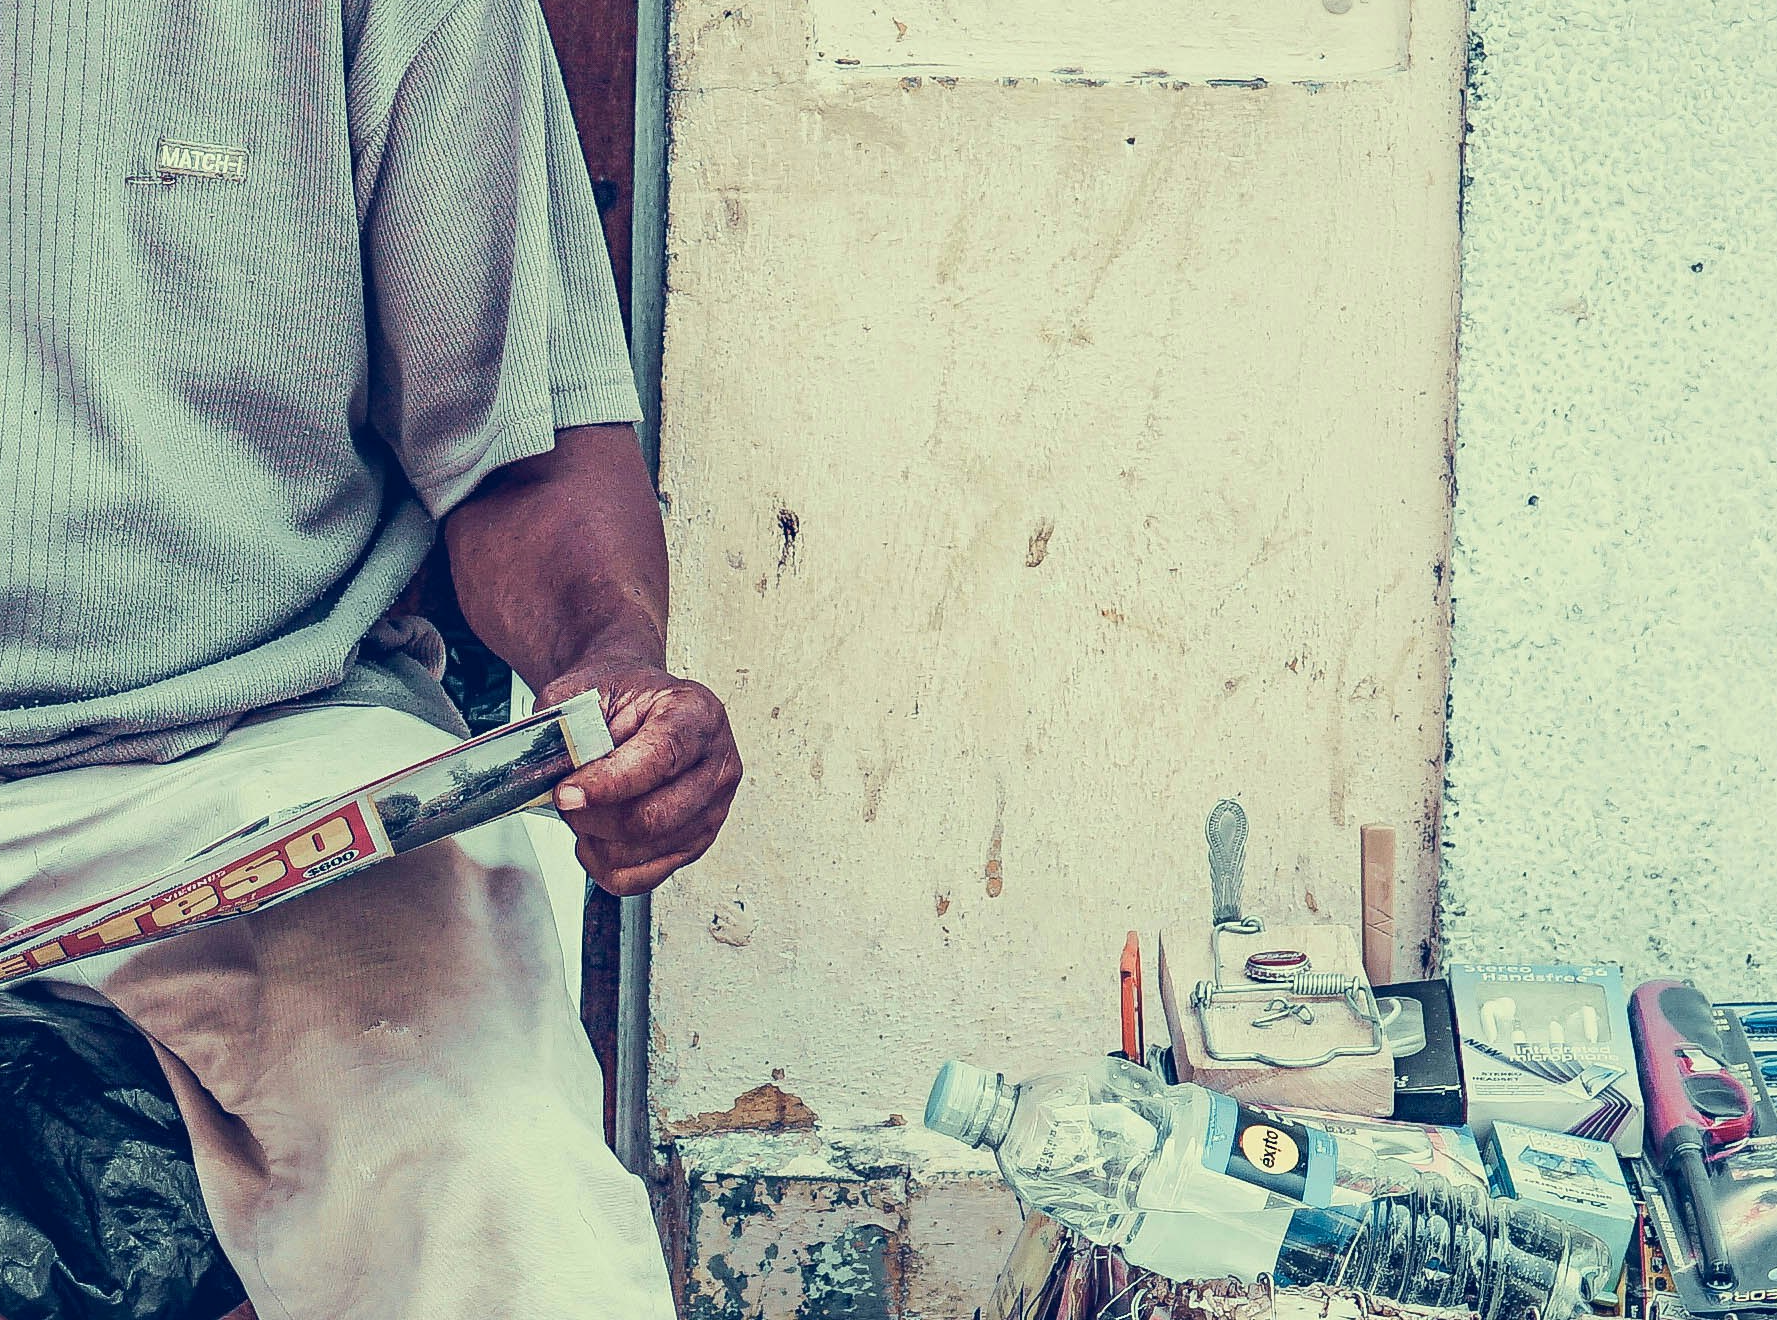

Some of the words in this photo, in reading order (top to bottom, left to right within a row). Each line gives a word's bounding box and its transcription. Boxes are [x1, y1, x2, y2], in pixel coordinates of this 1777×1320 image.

[1463, 964, 1532, 974] Stereo
[1482, 972, 1588, 983] Handsfree
[1463, 1037, 1503, 1057] NEW
[1515, 1044, 1612, 1056] Integrated
[1509, 1052, 1620, 1064] microphone
[1260, 1129, 1280, 1169] éxito
